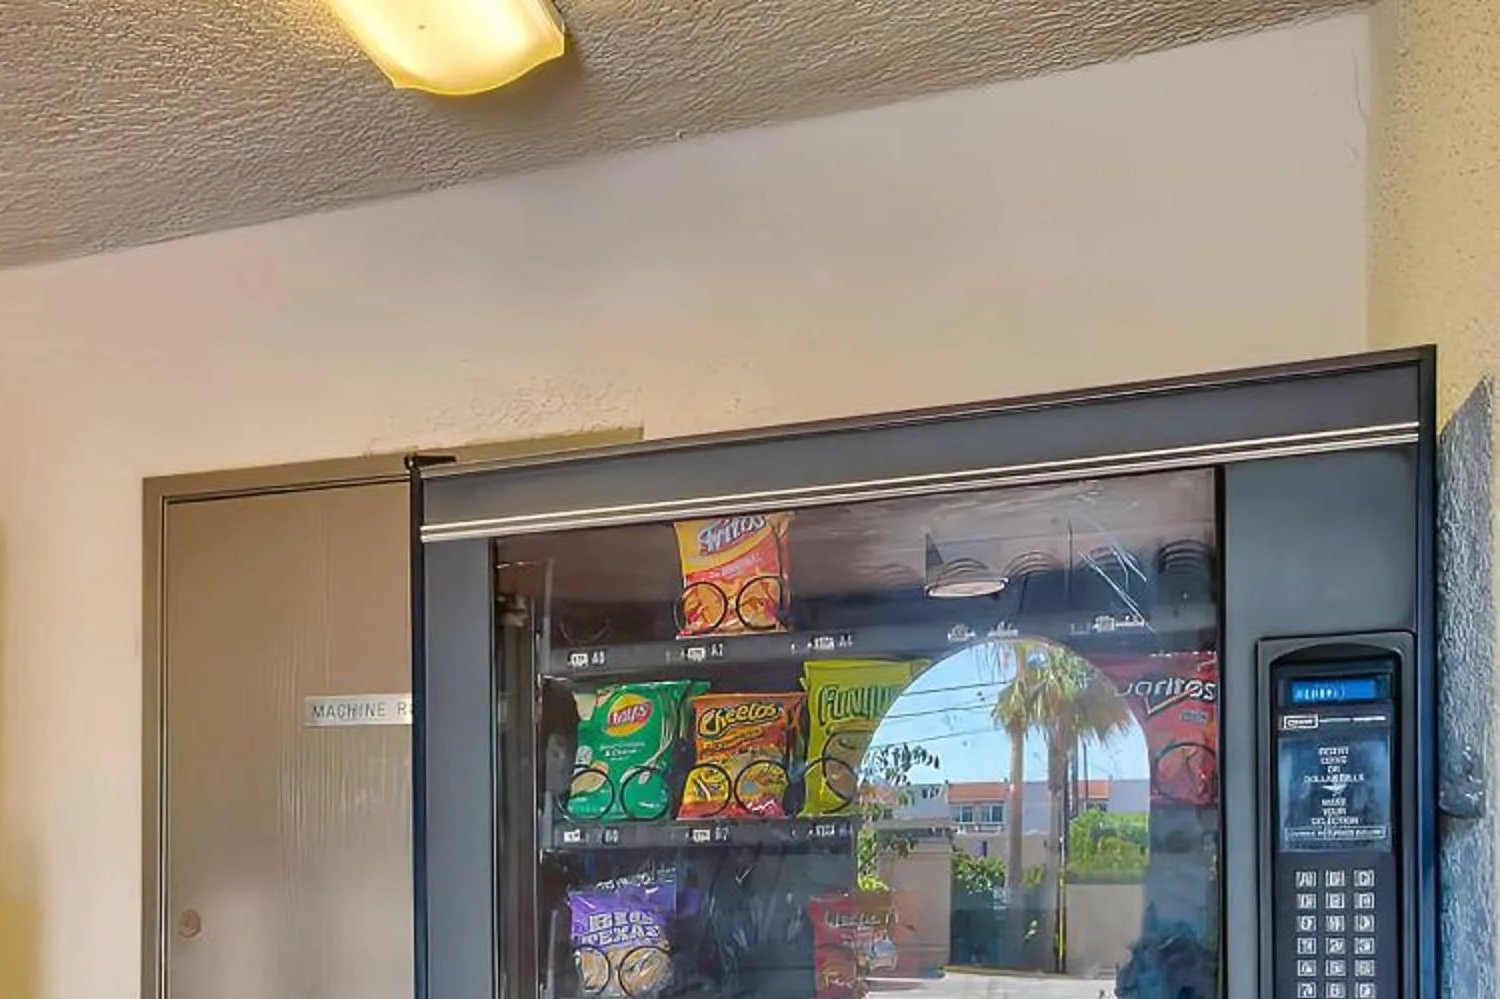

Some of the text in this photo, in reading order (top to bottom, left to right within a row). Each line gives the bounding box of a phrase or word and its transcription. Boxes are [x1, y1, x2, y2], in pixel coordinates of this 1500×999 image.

[311, 702, 386, 719] MACHINE
[700, 703, 781, 737] Cheetos
[581, 925, 660, 945] TEXAS
